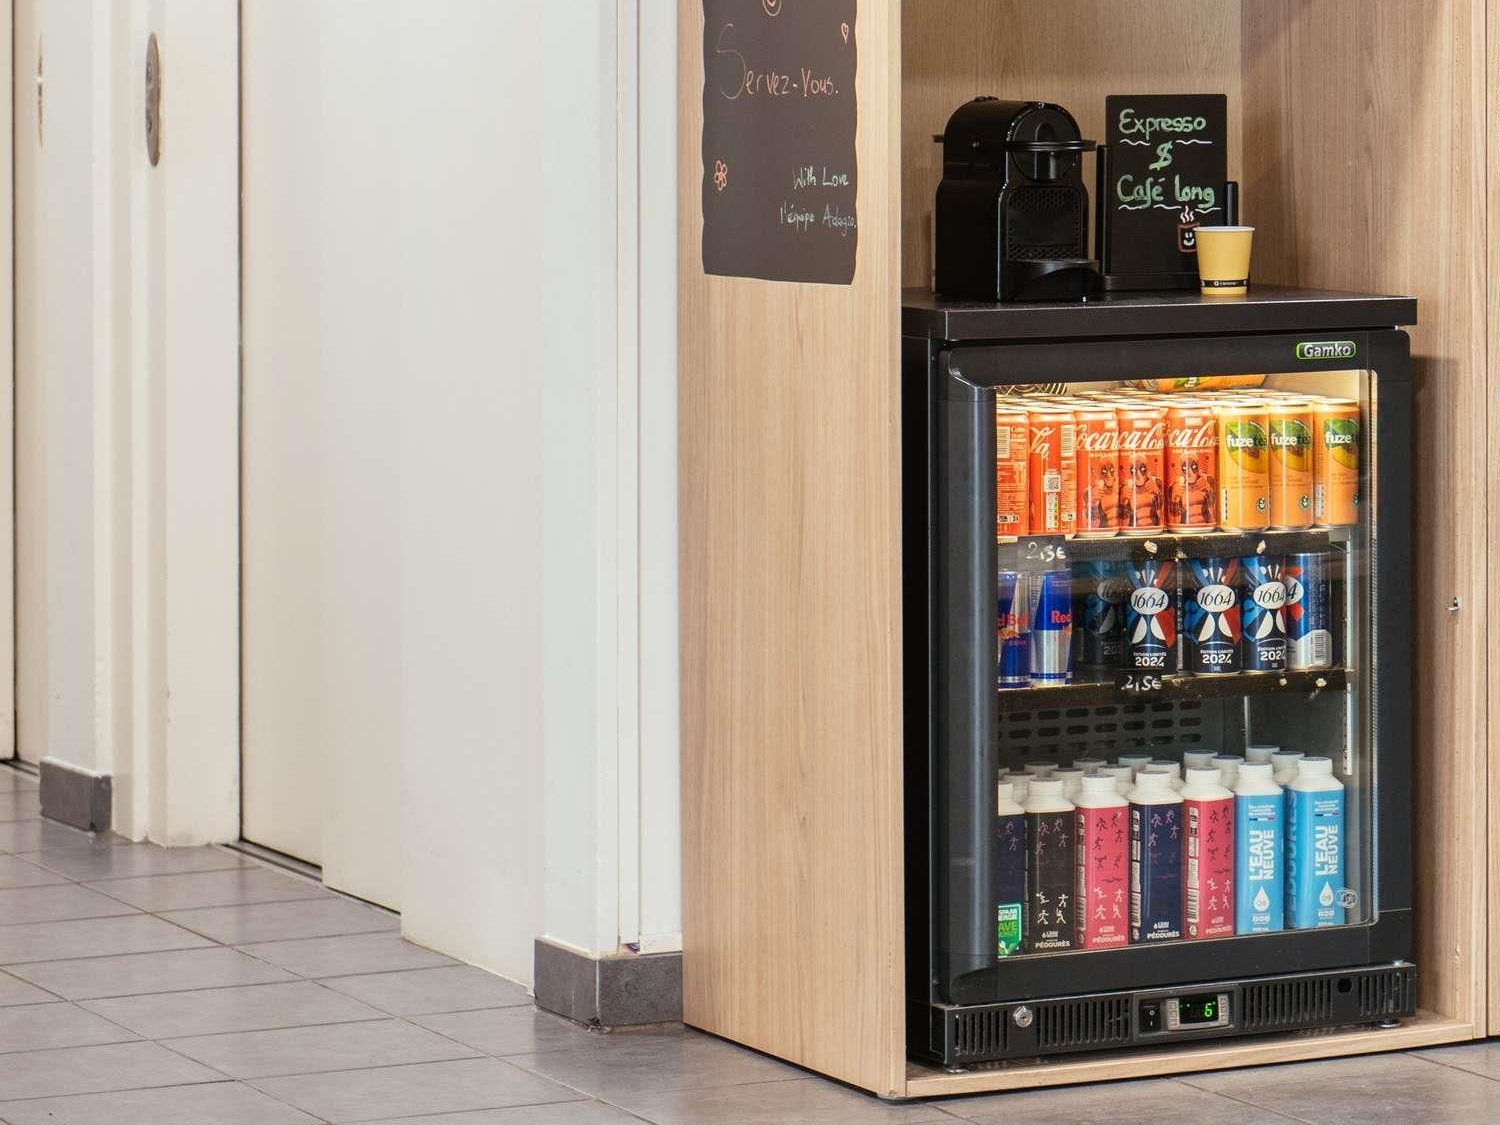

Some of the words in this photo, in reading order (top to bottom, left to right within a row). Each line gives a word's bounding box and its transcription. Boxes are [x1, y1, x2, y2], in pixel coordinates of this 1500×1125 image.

[1118, 108, 1206, 140] Expresso
[1117, 174, 1165, 209] Café
[1174, 174, 1215, 208] long
[1303, 343, 1352, 358] Gamko
[1133, 592, 1166, 609] 1664
[1200, 589, 1233, 606] 1664
[1135, 656, 1165, 667] 2024
[1202, 653, 1232, 664] 2024
[1248, 830, 1264, 881] L'EAU
[1264, 829, 1274, 880] NEUVE
[1315, 825, 1328, 876] L'EAU
[1328, 824, 1338, 875] NEUVE
